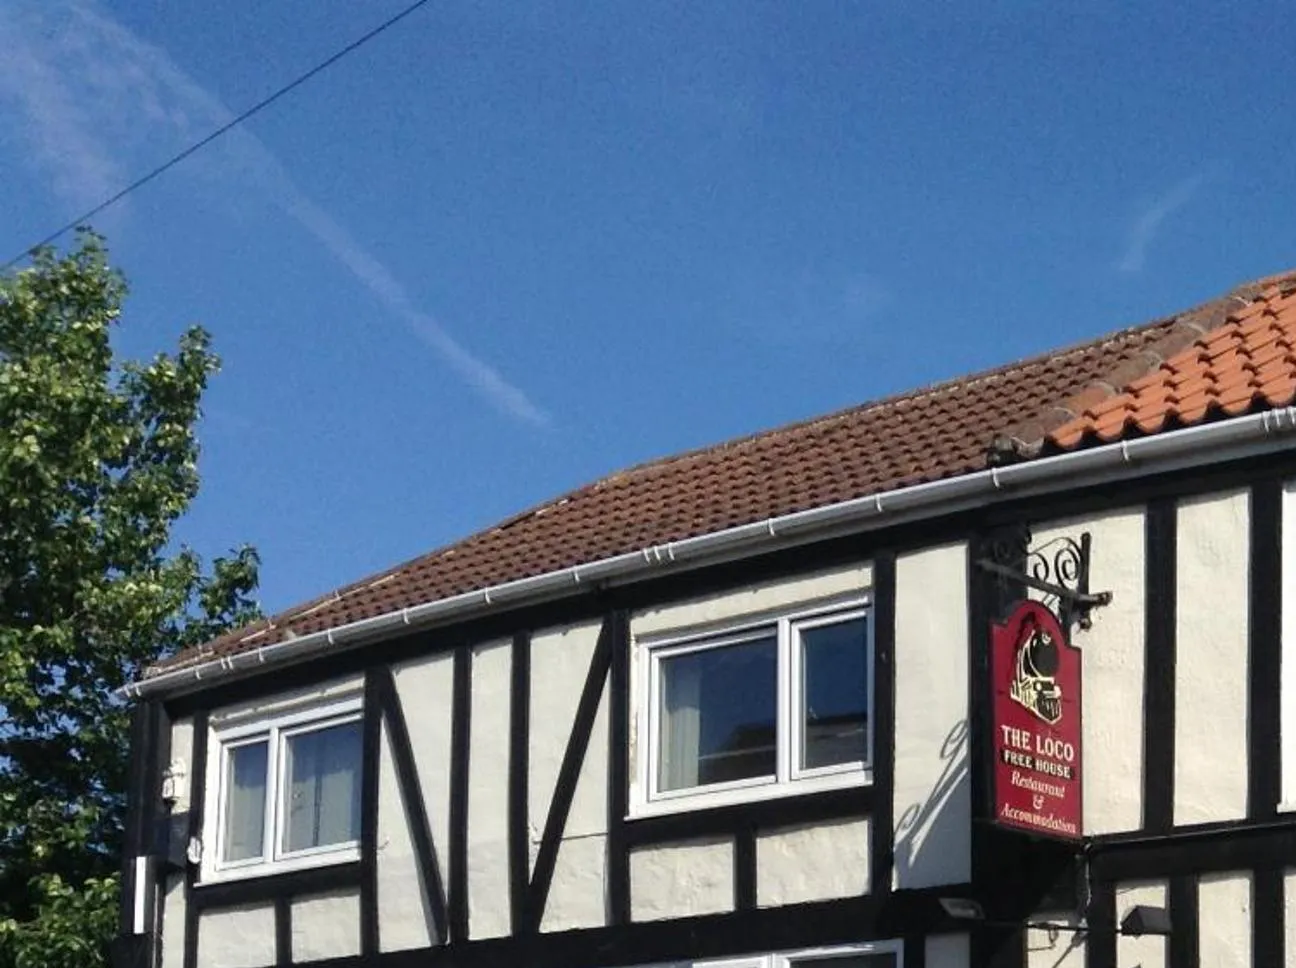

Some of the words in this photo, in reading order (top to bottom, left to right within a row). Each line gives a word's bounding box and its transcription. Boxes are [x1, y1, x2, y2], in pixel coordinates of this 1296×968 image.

[1000, 724, 1032, 751] THE
[1036, 734, 1074, 762] LOCO
[1004, 750, 1033, 769] FREE
[1036, 760, 1071, 779] HOUSE
[1011, 770, 1066, 798] Restaurant
[1032, 794, 1045, 810] &
